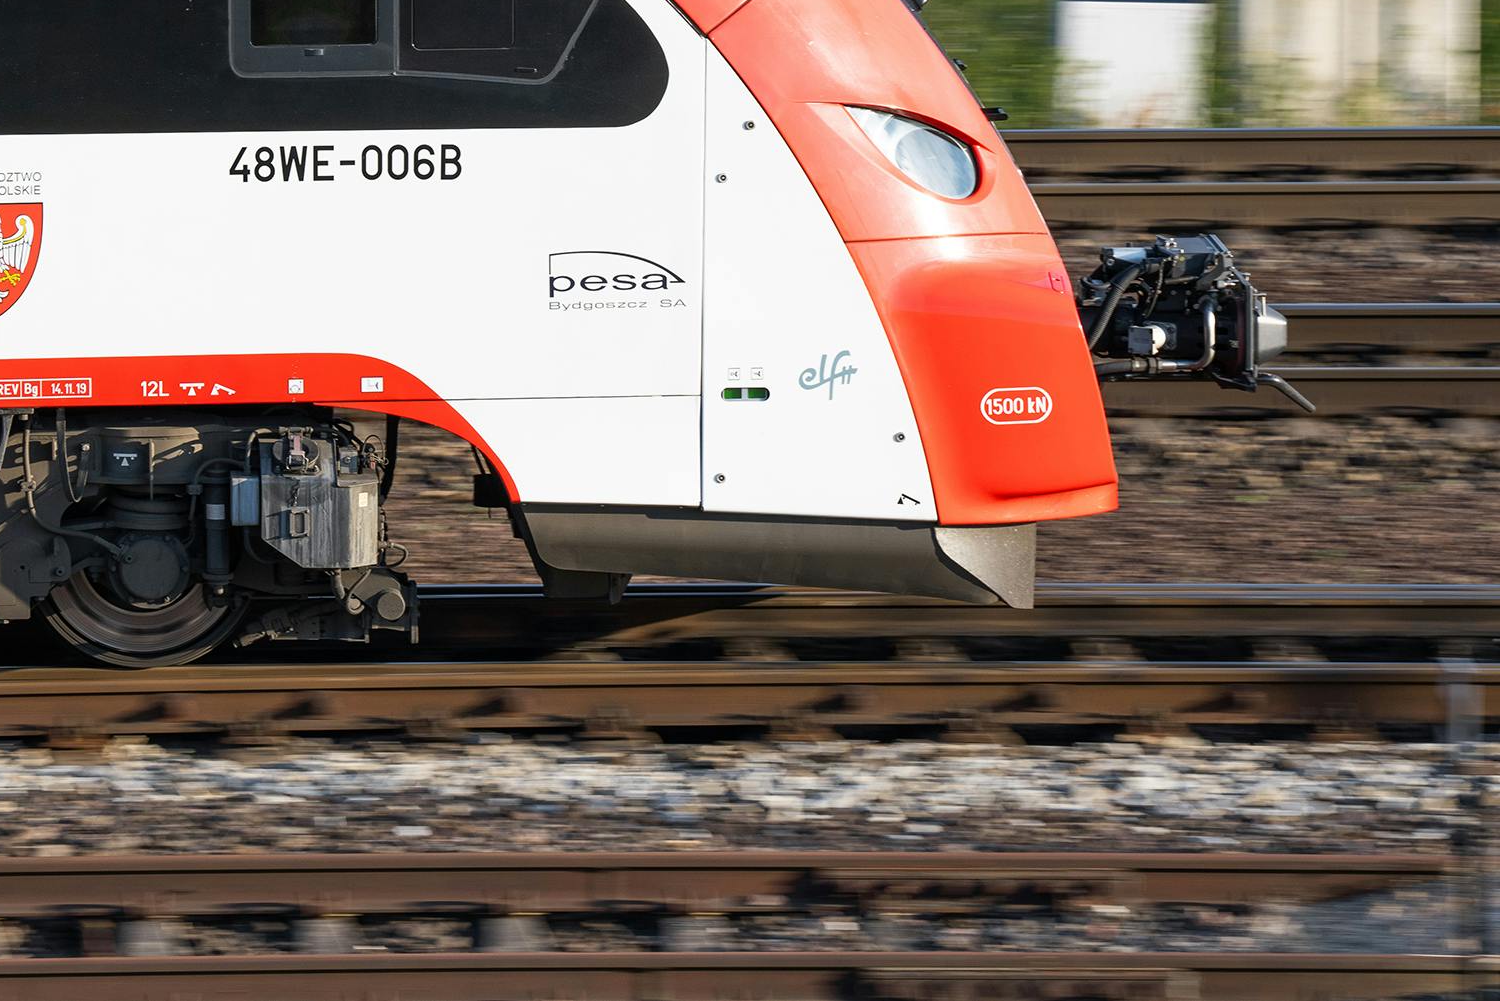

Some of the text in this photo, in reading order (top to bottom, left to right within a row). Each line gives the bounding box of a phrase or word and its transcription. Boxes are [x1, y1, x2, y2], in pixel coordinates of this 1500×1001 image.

[228, 144, 462, 183] 48WE-006B
[549, 273, 668, 298] pesa
[549, 299, 687, 311] Bydgoszcz SA
[24, 383, 38, 397] Bg
[141, 380, 169, 397] 12L
[986, 396, 1046, 415] 1500 kN
